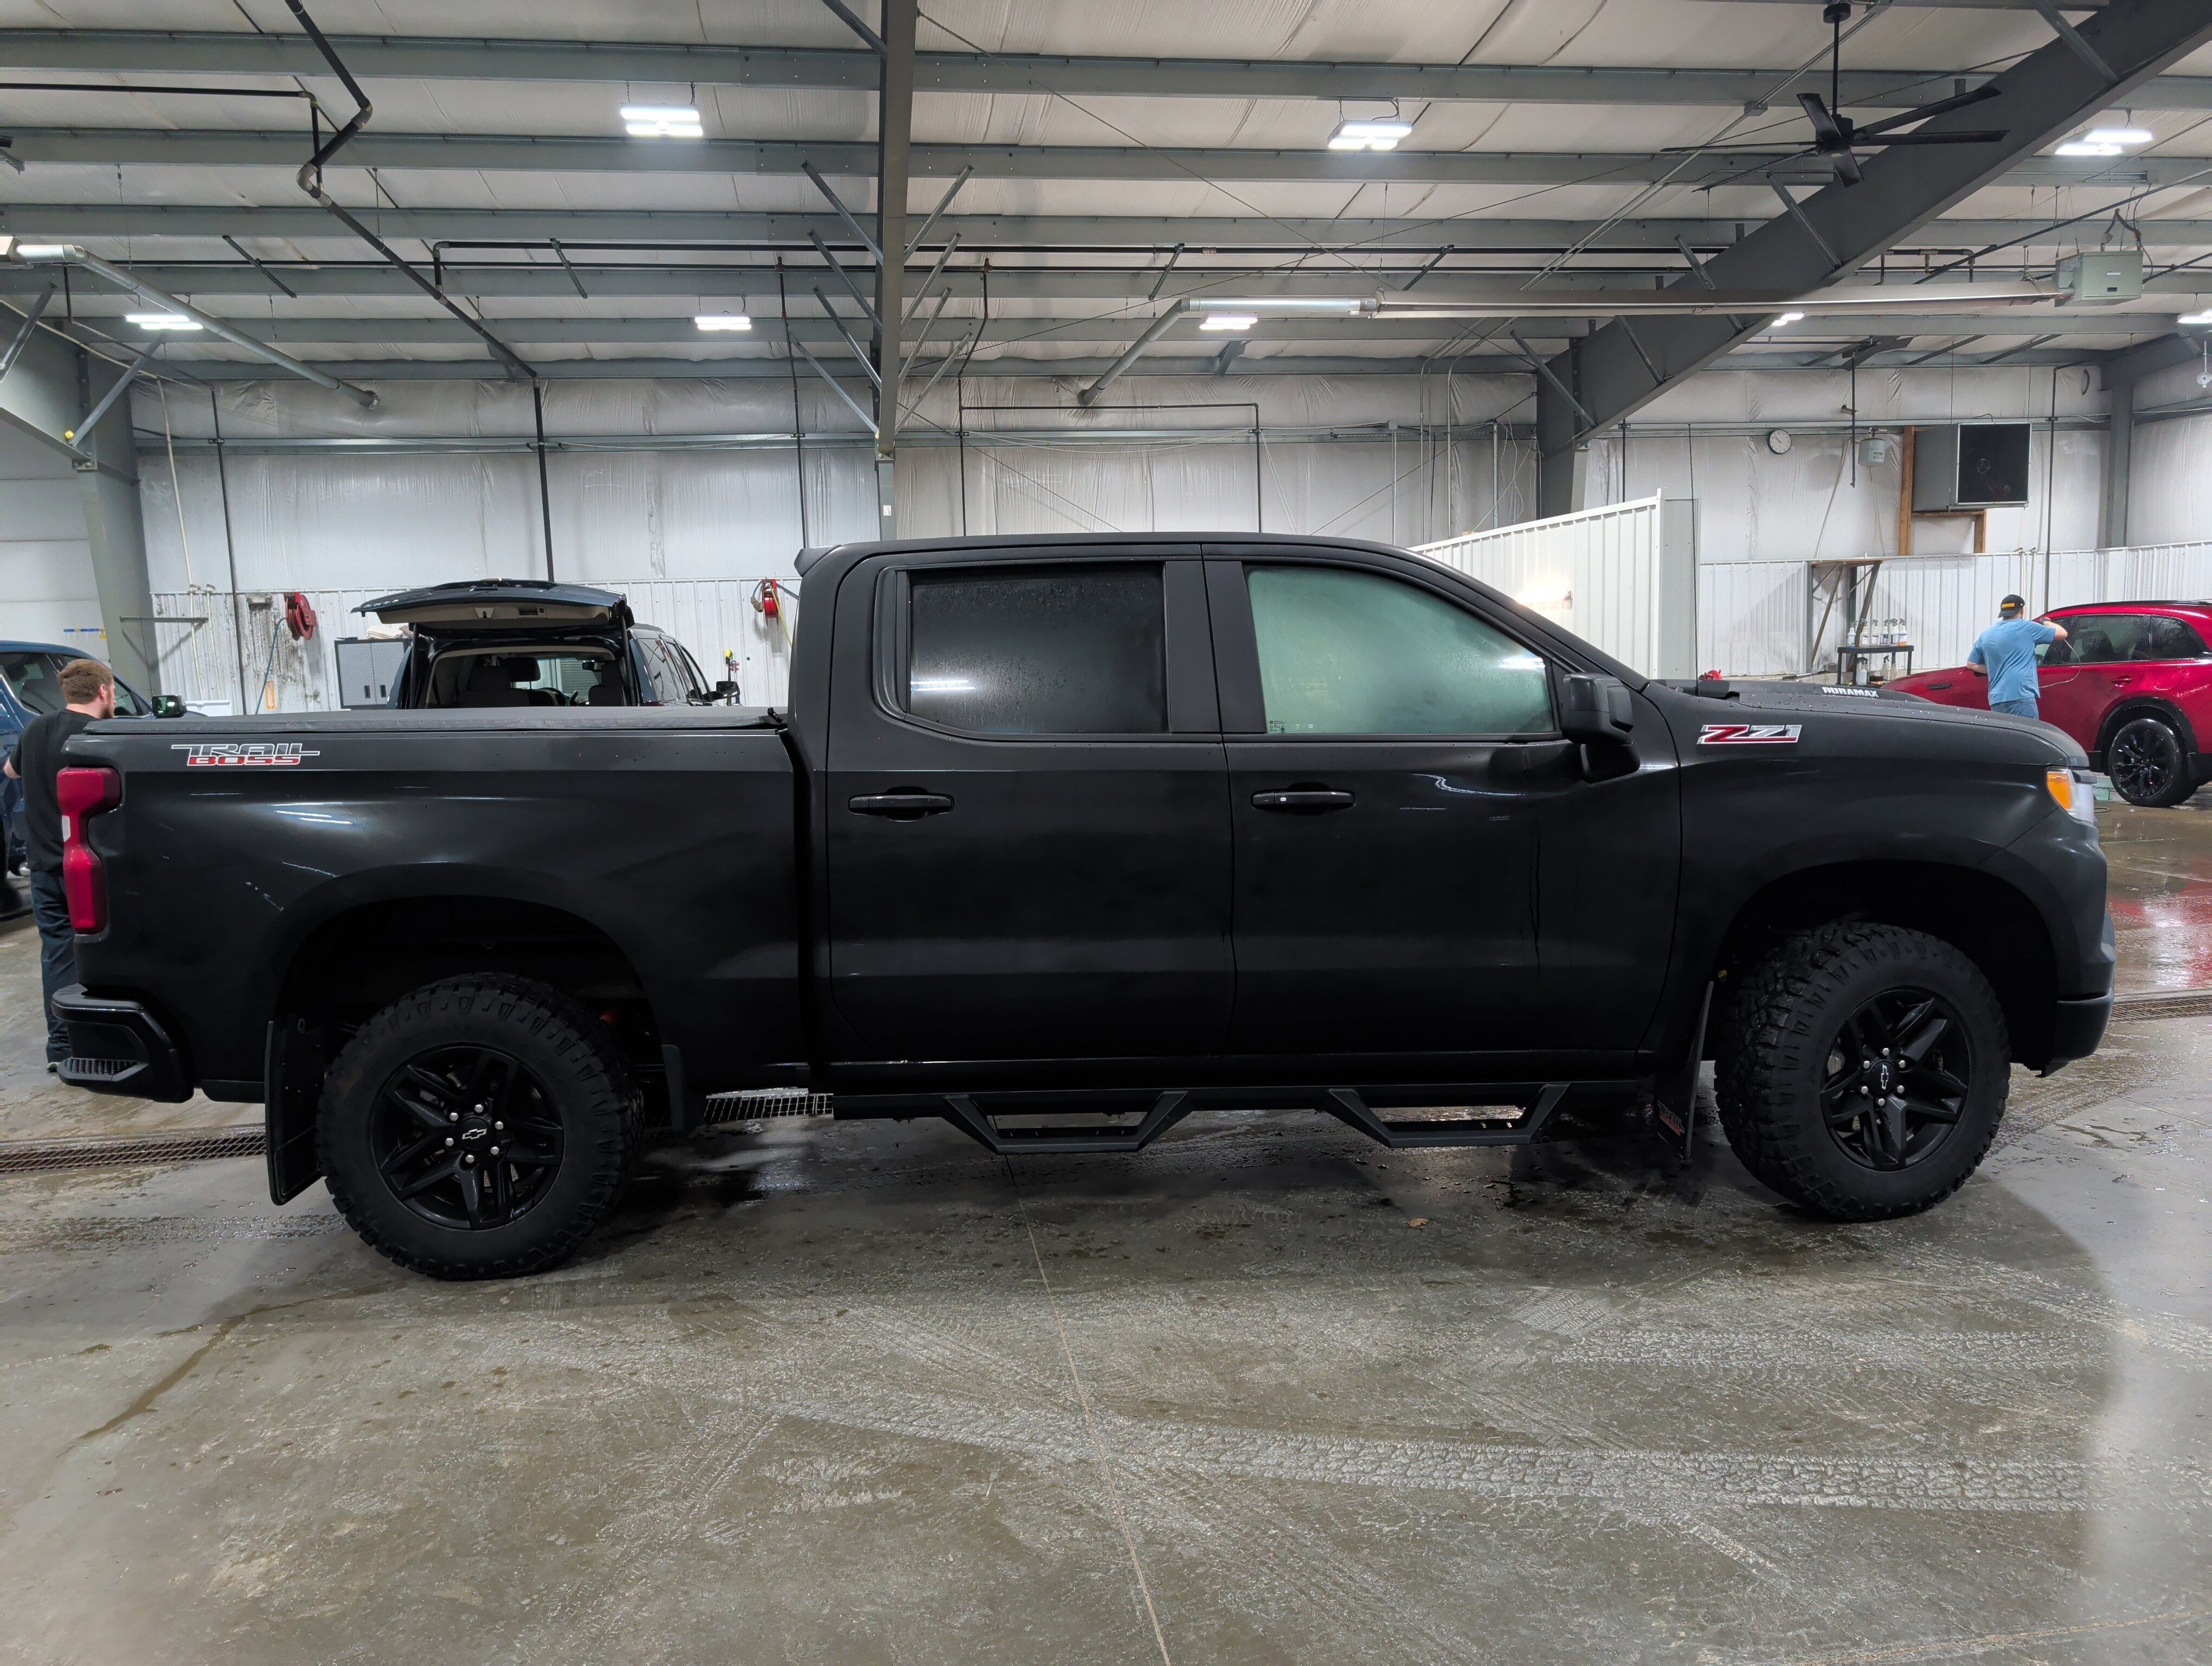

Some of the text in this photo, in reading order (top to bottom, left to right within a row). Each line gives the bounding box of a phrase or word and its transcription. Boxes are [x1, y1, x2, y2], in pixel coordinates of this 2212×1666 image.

[1822, 687, 1880, 698] DURAMAX
[1696, 725, 1802, 745] Z71
[171, 744, 320, 755] TRAIL
[187, 755, 301, 766] BOSS
